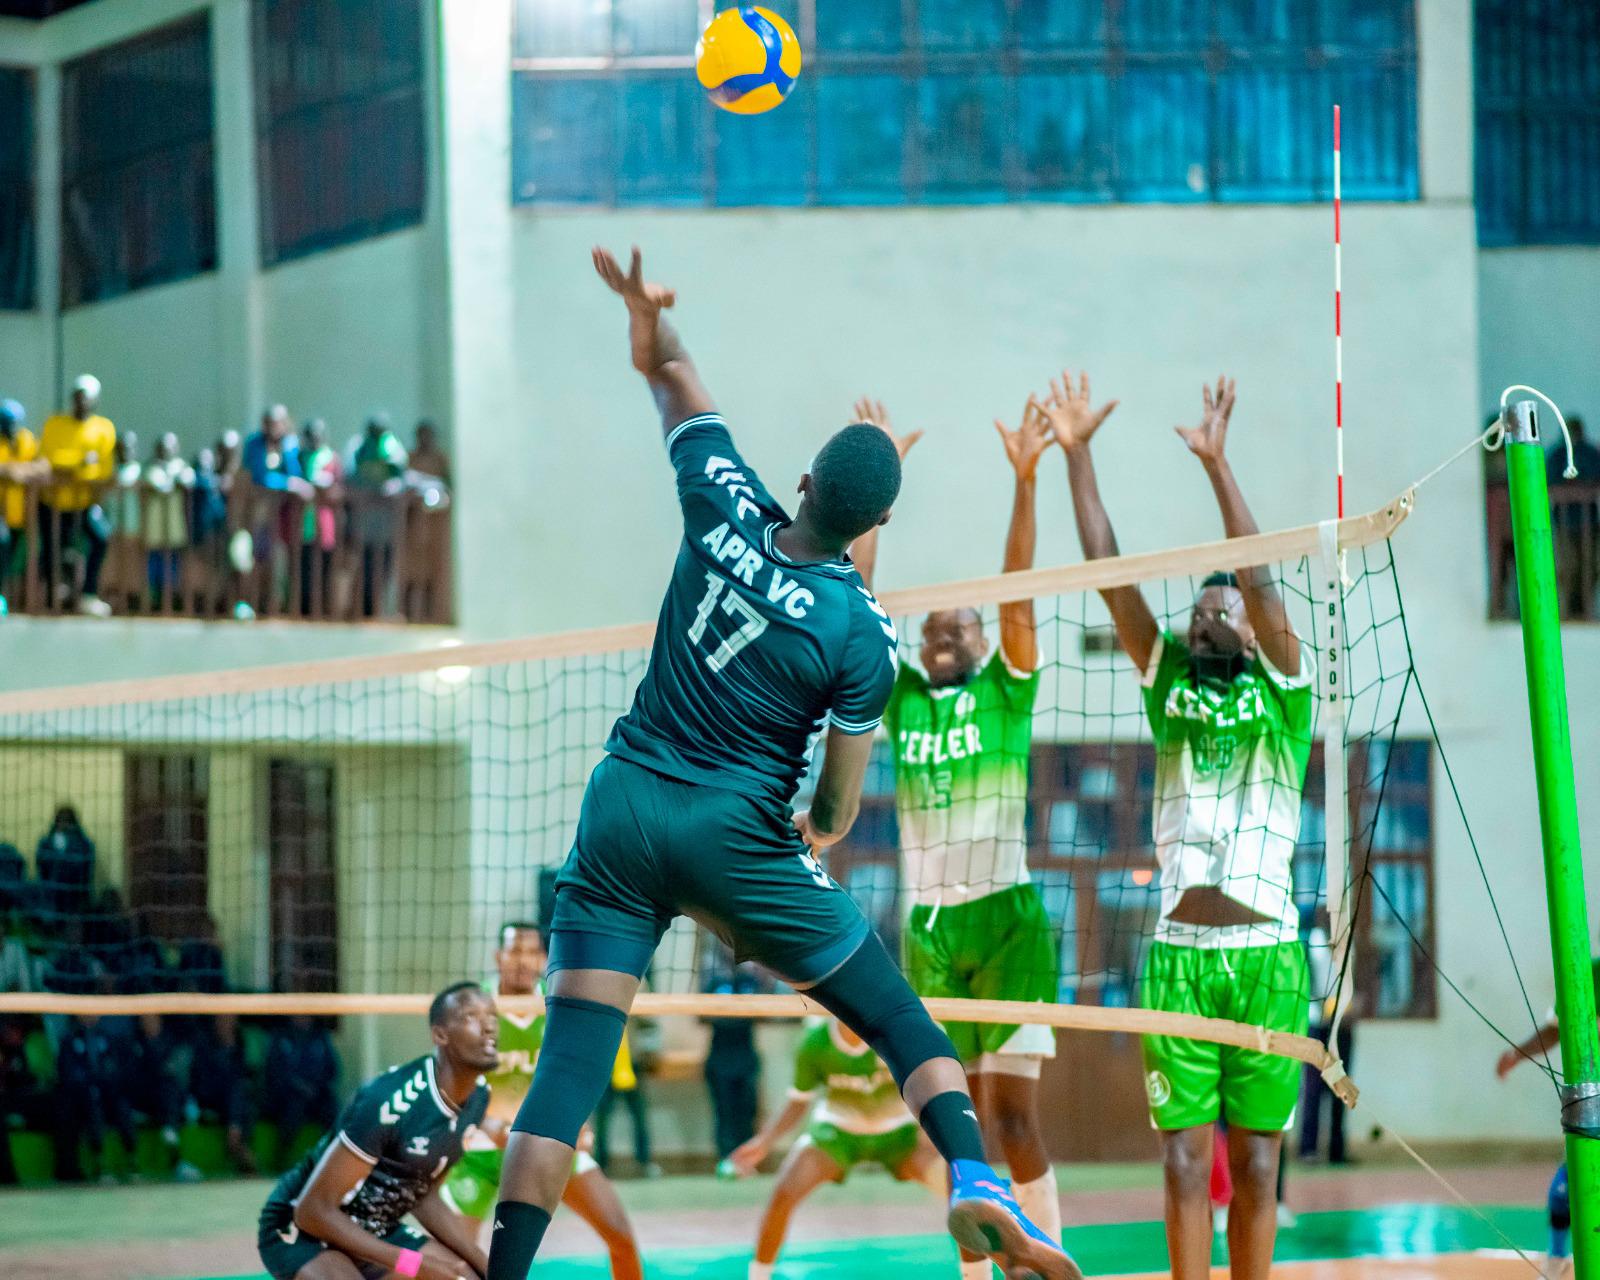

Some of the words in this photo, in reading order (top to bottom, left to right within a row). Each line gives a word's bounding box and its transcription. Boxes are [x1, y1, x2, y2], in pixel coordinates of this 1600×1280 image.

[702, 522, 764, 587] APR
[767, 568, 815, 619] VC
[688, 569, 770, 673] 17
